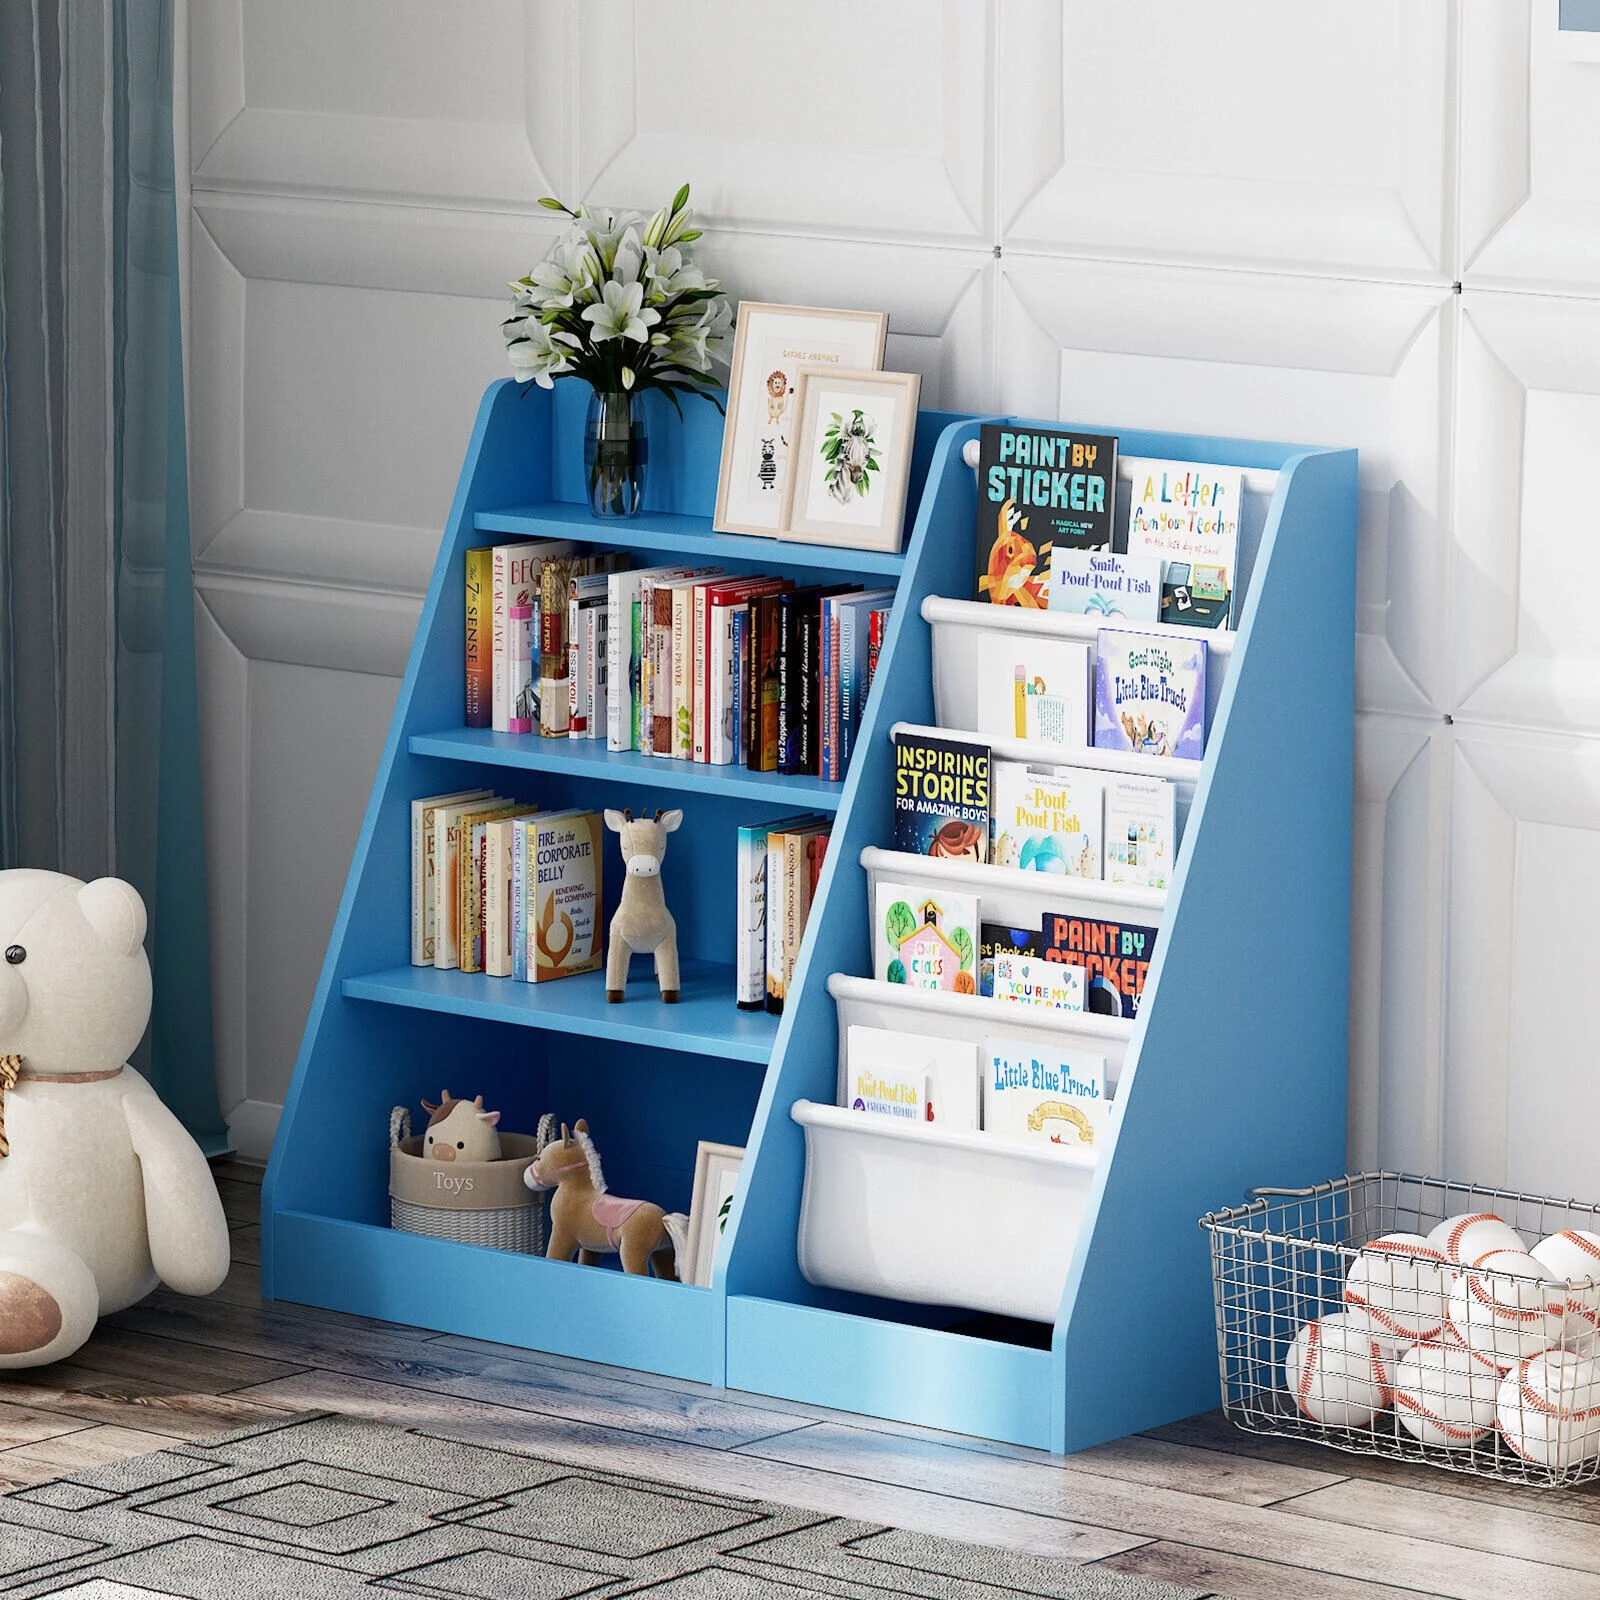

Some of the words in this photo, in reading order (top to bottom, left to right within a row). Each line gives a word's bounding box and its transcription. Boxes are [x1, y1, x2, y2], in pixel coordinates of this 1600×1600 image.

[1000, 433, 1070, 468] PAINT
[1072, 444, 1097, 468] BY
[988, 466, 1105, 512] STICKER
[1143, 476, 1154, 502] A
[1161, 473, 1225, 507] Letter
[1133, 507, 1158, 532] from
[1160, 512, 1185, 532] your
[1188, 510, 1235, 534] Teacher
[1090, 557, 1125, 572] Smile,
[494, 565, 504, 616] BECAUSE
[1127, 579, 1151, 593] Fish
[544, 616, 550, 628] OF
[467, 606, 478, 663] SENSE
[675, 642, 680, 651] IN
[1129, 648, 1148, 669] Good
[1116, 676, 1138, 704] Little
[1141, 674, 1159, 700] Blue
[1160, 676, 1186, 713] Truck
[473, 702, 478, 713] TO
[778, 711, 787, 746] Zeppelin
[896, 745, 987, 779] INSPIRING
[896, 769, 987, 807] STORIES
[896, 798, 915, 812] FOR
[916, 801, 959, 819] AMAZING
[962, 807, 987, 822] BOYS
[1016, 806, 1048, 829] Pout
[1052, 812, 1080, 832] Fish
[538, 831, 556, 847] FIRE
[557, 832, 564, 843] in
[564, 830, 576, 842] the
[538, 842, 591, 865] CORPORATE
[515, 862, 520, 872] OF
[538, 865, 565, 883] BELLY
[556, 883, 584, 895] RENEWING
[1054, 918, 1120, 955] PAINT
[1122, 931, 1144, 956] BY
[1009, 982, 1048, 998] YOU'RE
[1052, 988, 1068, 1001] MY
[994, 1058, 1028, 1090] Little
[1032, 1059, 1059, 1091] Blue
[900, 1084, 917, 1105] Fish
[433, 1172, 474, 1196] Toys
